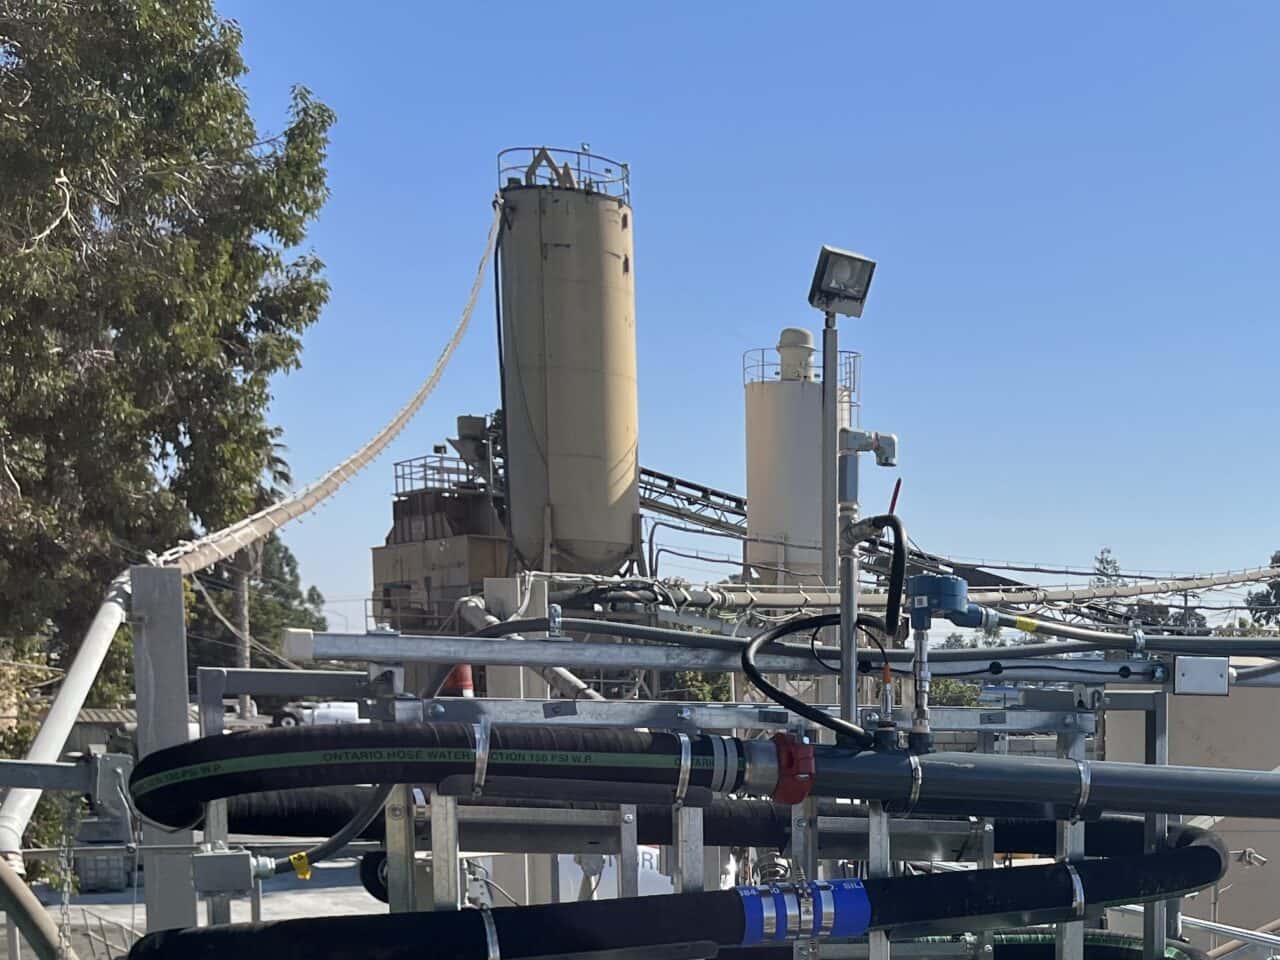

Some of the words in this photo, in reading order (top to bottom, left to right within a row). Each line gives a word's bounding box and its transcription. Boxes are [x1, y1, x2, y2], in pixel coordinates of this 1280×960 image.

[322, 750, 380, 761] ONTARIO
[388, 750, 425, 760] HOSE
[428, 750, 472, 760] WATER
